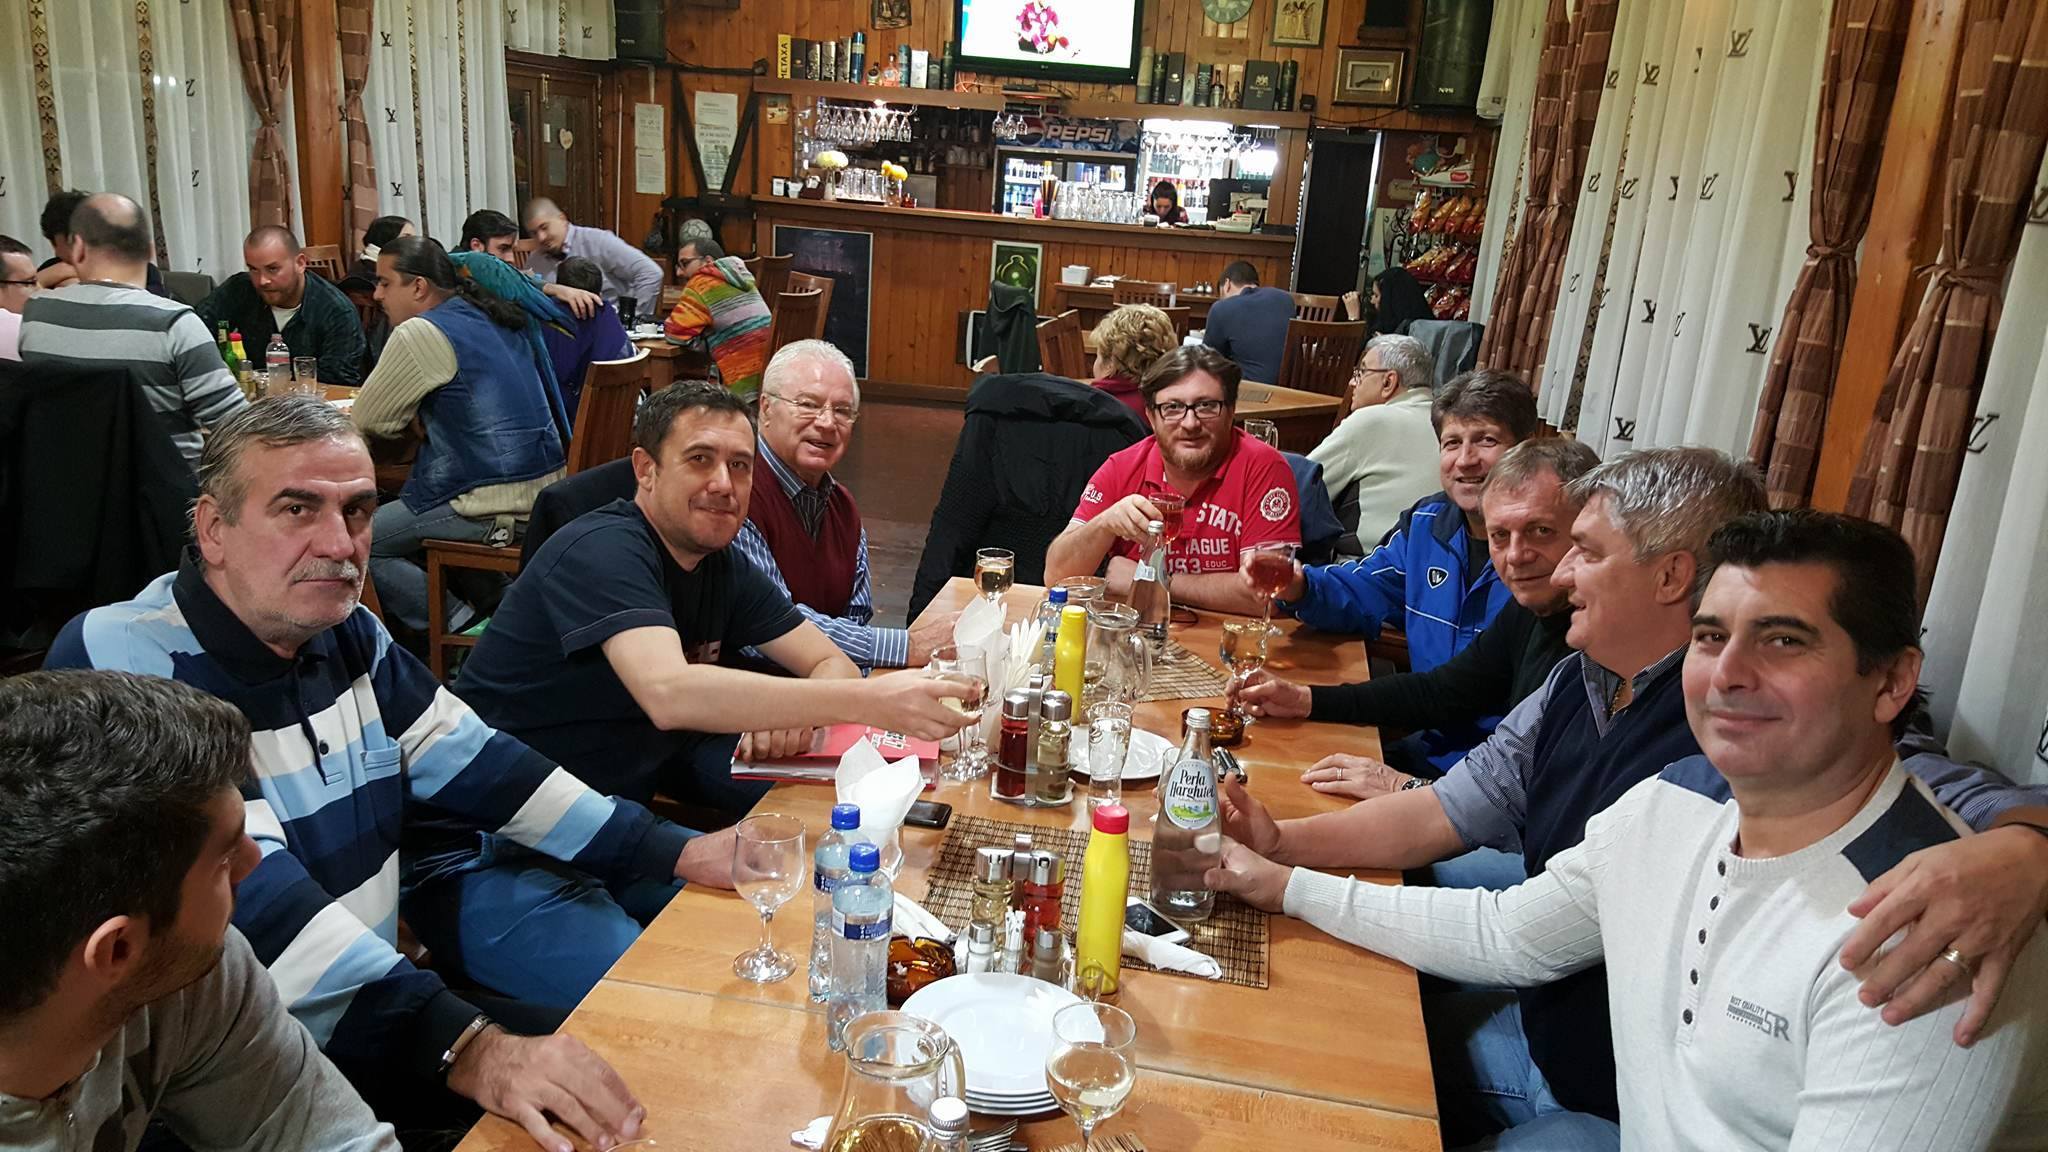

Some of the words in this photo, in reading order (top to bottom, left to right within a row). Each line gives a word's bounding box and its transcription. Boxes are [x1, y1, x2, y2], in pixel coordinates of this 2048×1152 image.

[1046, 124, 1112, 144] PEPSI
[1205, 560, 1227, 569] EDUC
[1180, 769, 1206, 786] Perla
